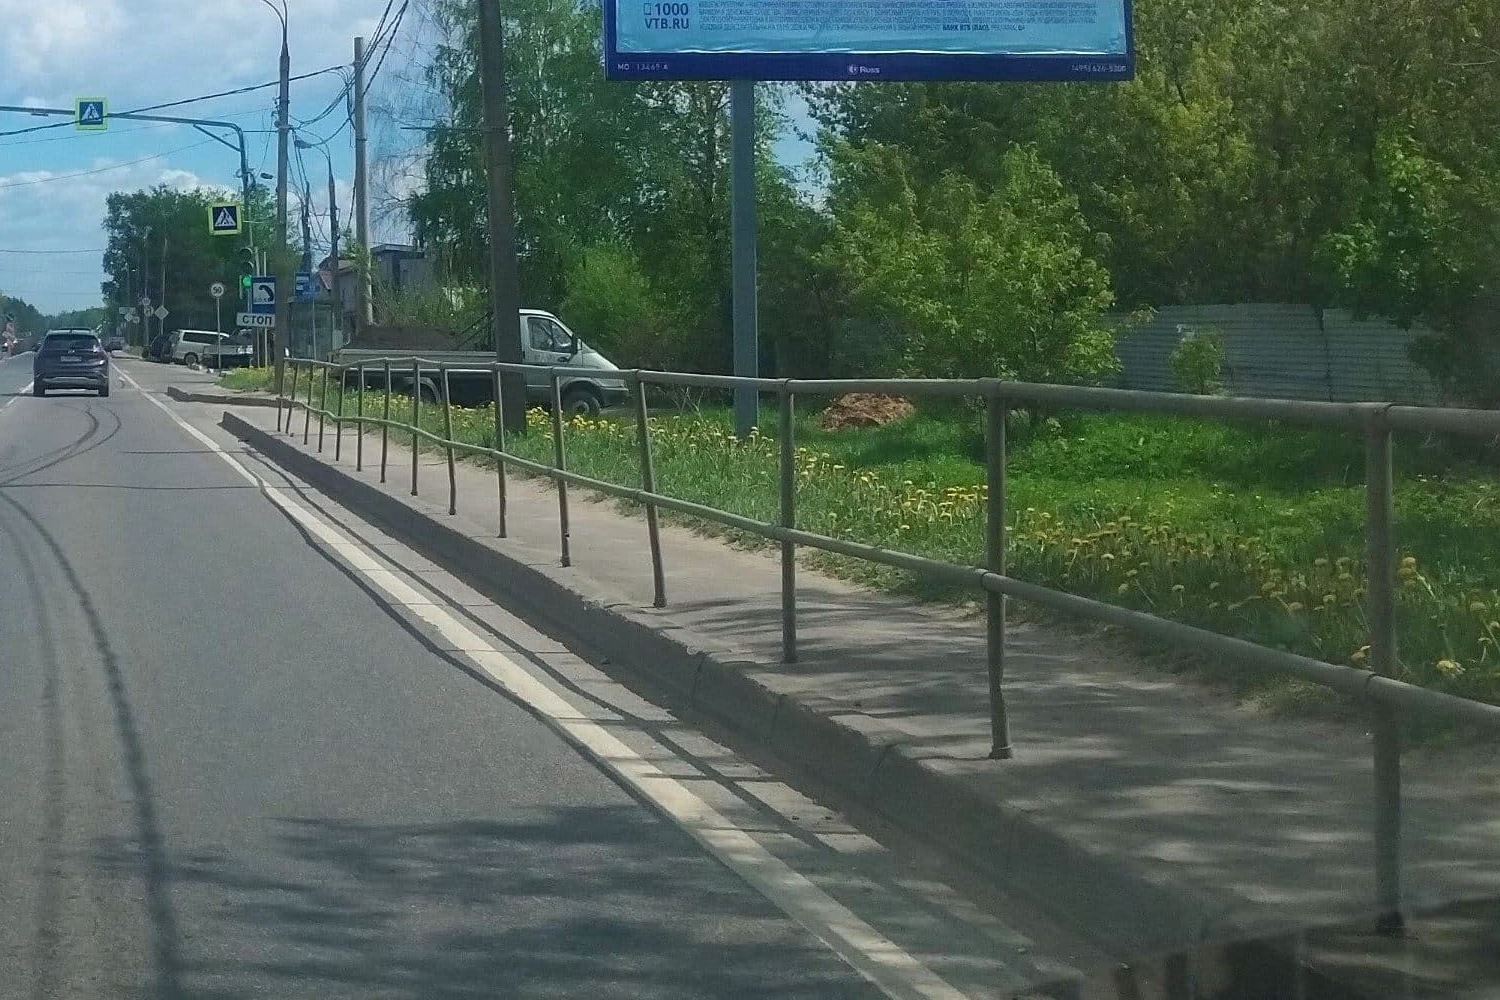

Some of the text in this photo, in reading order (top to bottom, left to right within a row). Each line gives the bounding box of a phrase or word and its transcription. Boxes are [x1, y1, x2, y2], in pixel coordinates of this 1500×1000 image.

[654, 2, 689, 16] 1000
[644, 18, 690, 30] VTB.RU
[242, 314, 272, 325] СТОП
